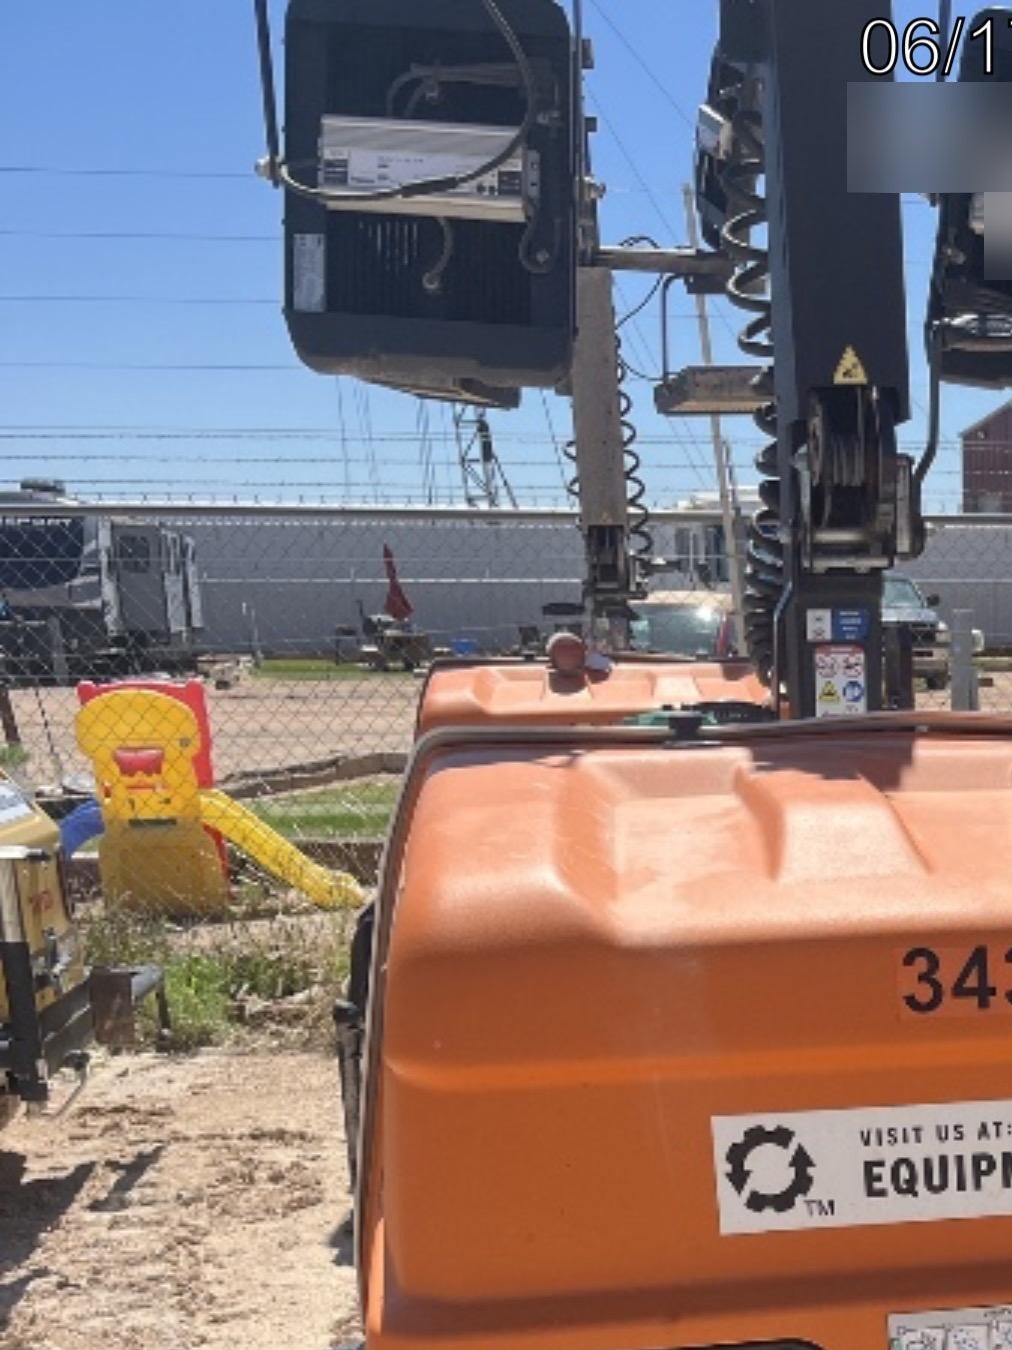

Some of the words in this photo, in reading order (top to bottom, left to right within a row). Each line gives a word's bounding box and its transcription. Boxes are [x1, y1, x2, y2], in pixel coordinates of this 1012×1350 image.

[860, 1126, 923, 1148] VISIT
[935, 1123, 965, 1142] US
[805, 1199, 836, 1217] TM
